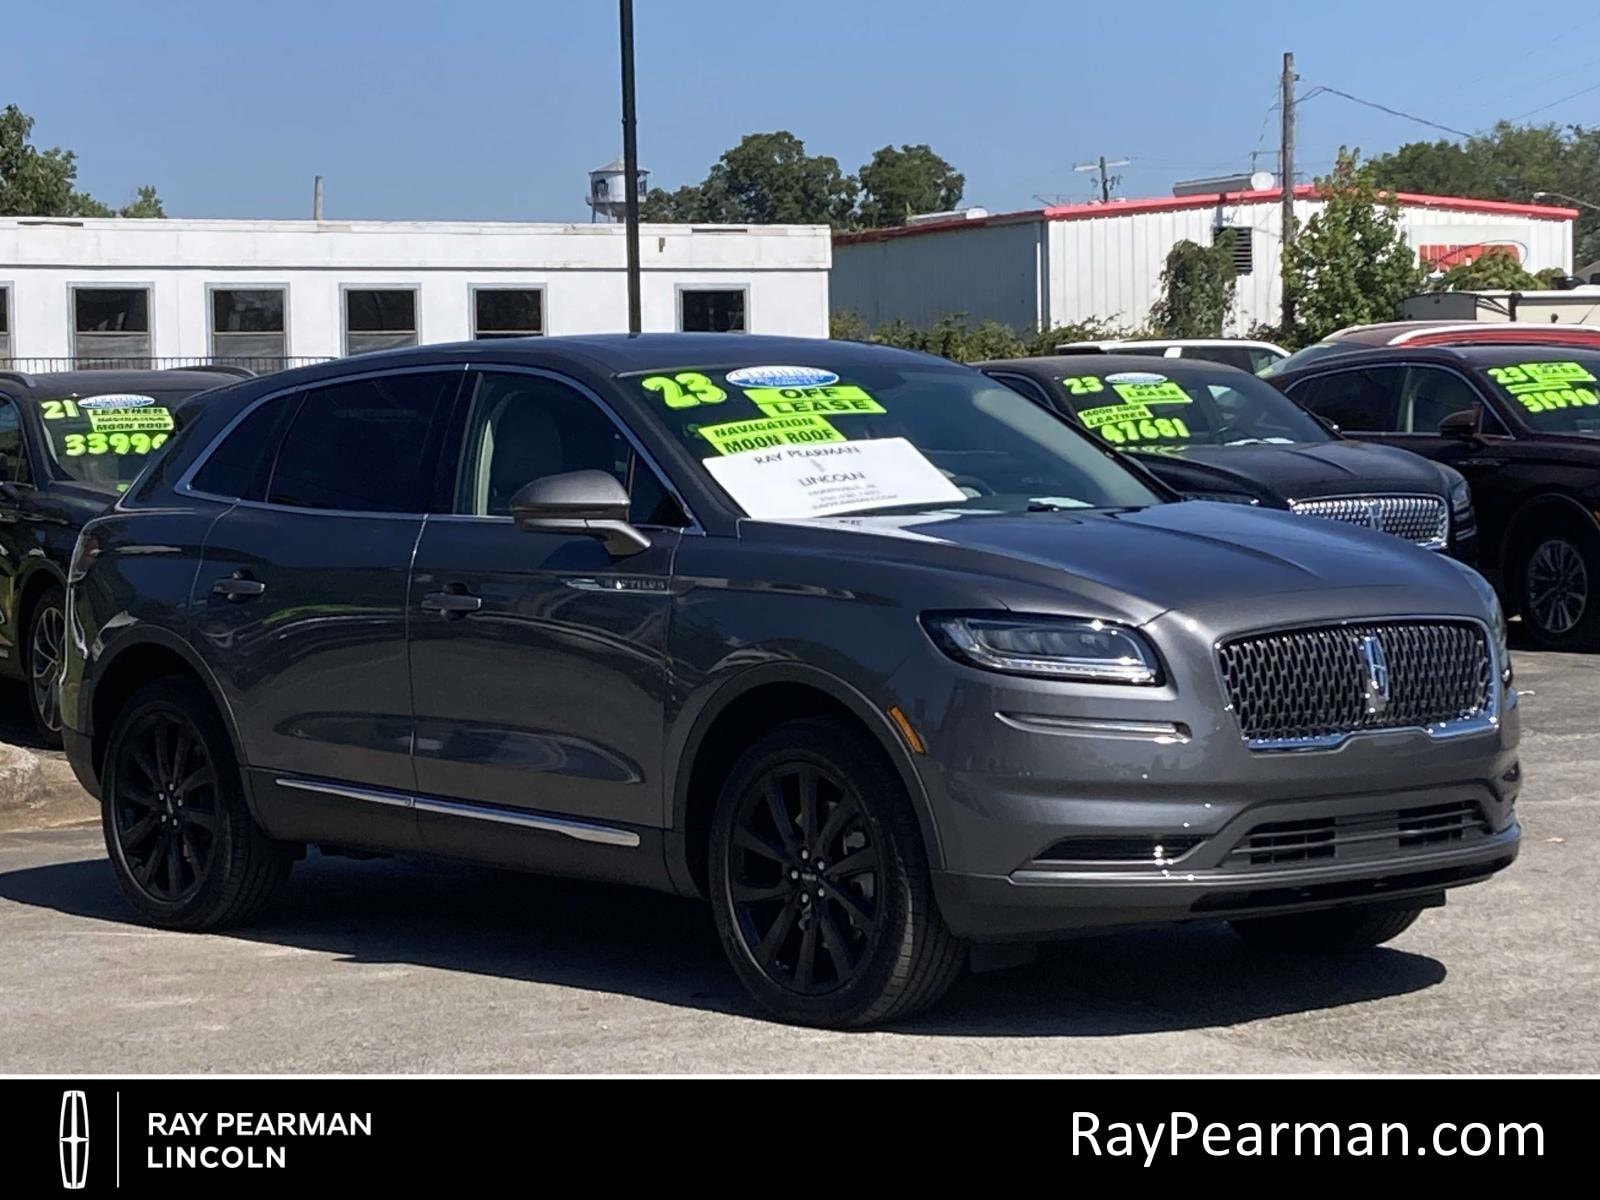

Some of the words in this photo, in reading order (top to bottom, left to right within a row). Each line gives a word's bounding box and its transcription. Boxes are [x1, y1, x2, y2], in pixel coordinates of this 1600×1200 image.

[1487, 367, 1528, 384] 23
[642, 373, 727, 410] 23
[779, 387, 839, 400] OFF
[1063, 376, 1104, 394] 23
[41, 400, 78, 419] 21
[92, 408, 163, 416] LEATHER
[773, 400, 871, 414] LEASE
[96, 423, 133, 431] MOON
[1089, 411, 1148, 426] LEATHER
[712, 417, 816, 438] NAVIGATION
[723, 434, 783, 454] MOON
[788, 428, 836, 444] ROOF
[753, 452, 783, 465] RAY
[787, 446, 862, 460] PEARMAN
[798, 472, 867, 487] LINCOLN
